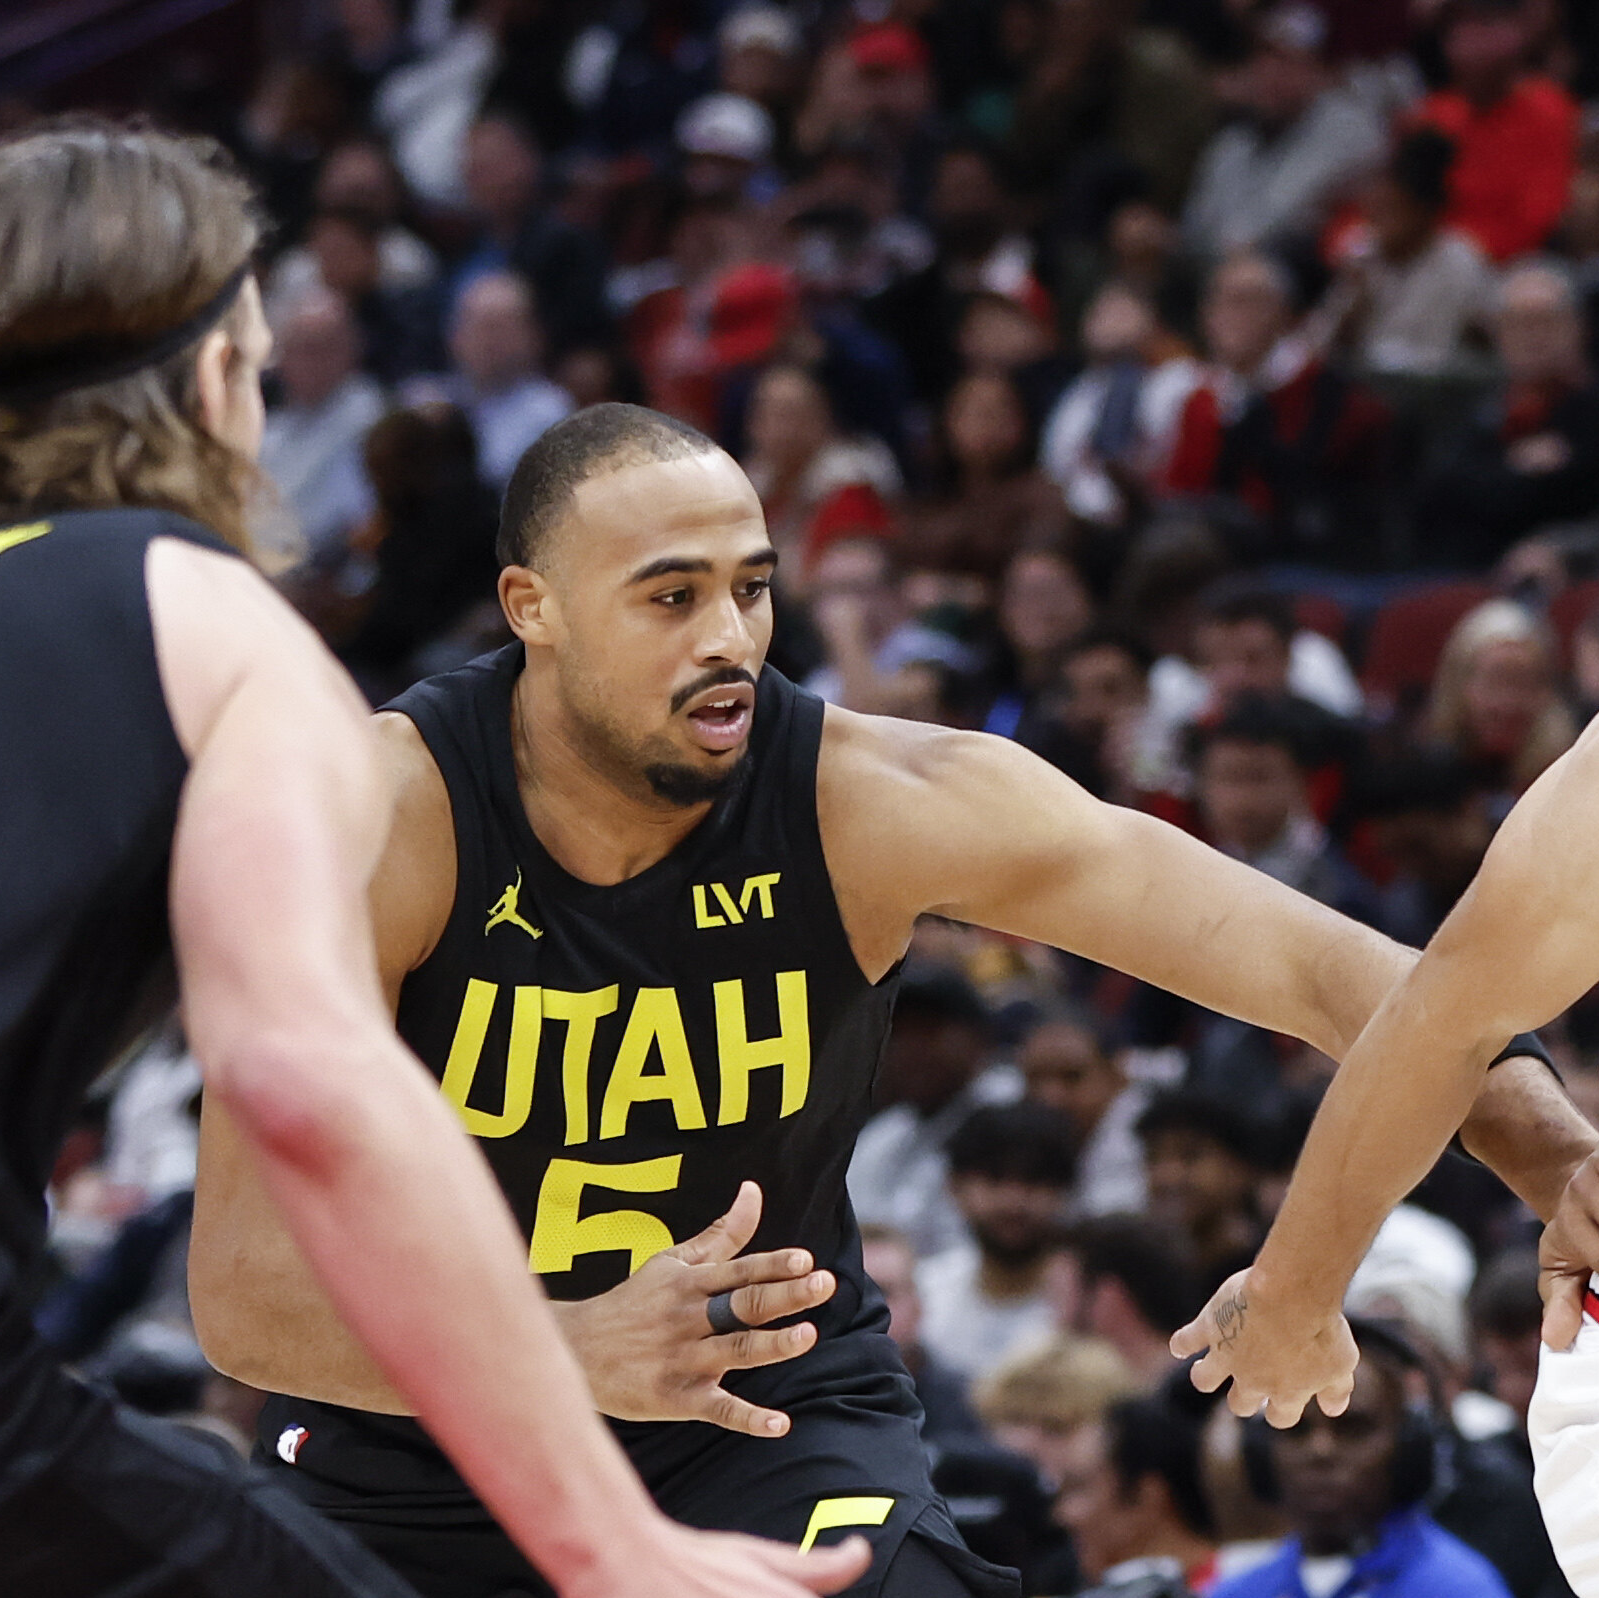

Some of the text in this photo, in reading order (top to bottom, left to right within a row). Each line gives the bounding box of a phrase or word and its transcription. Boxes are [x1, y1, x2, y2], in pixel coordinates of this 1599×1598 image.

[693, 872, 781, 929] LVT
[438, 969, 811, 1145] UTAH
[529, 1153, 683, 1278] 5
